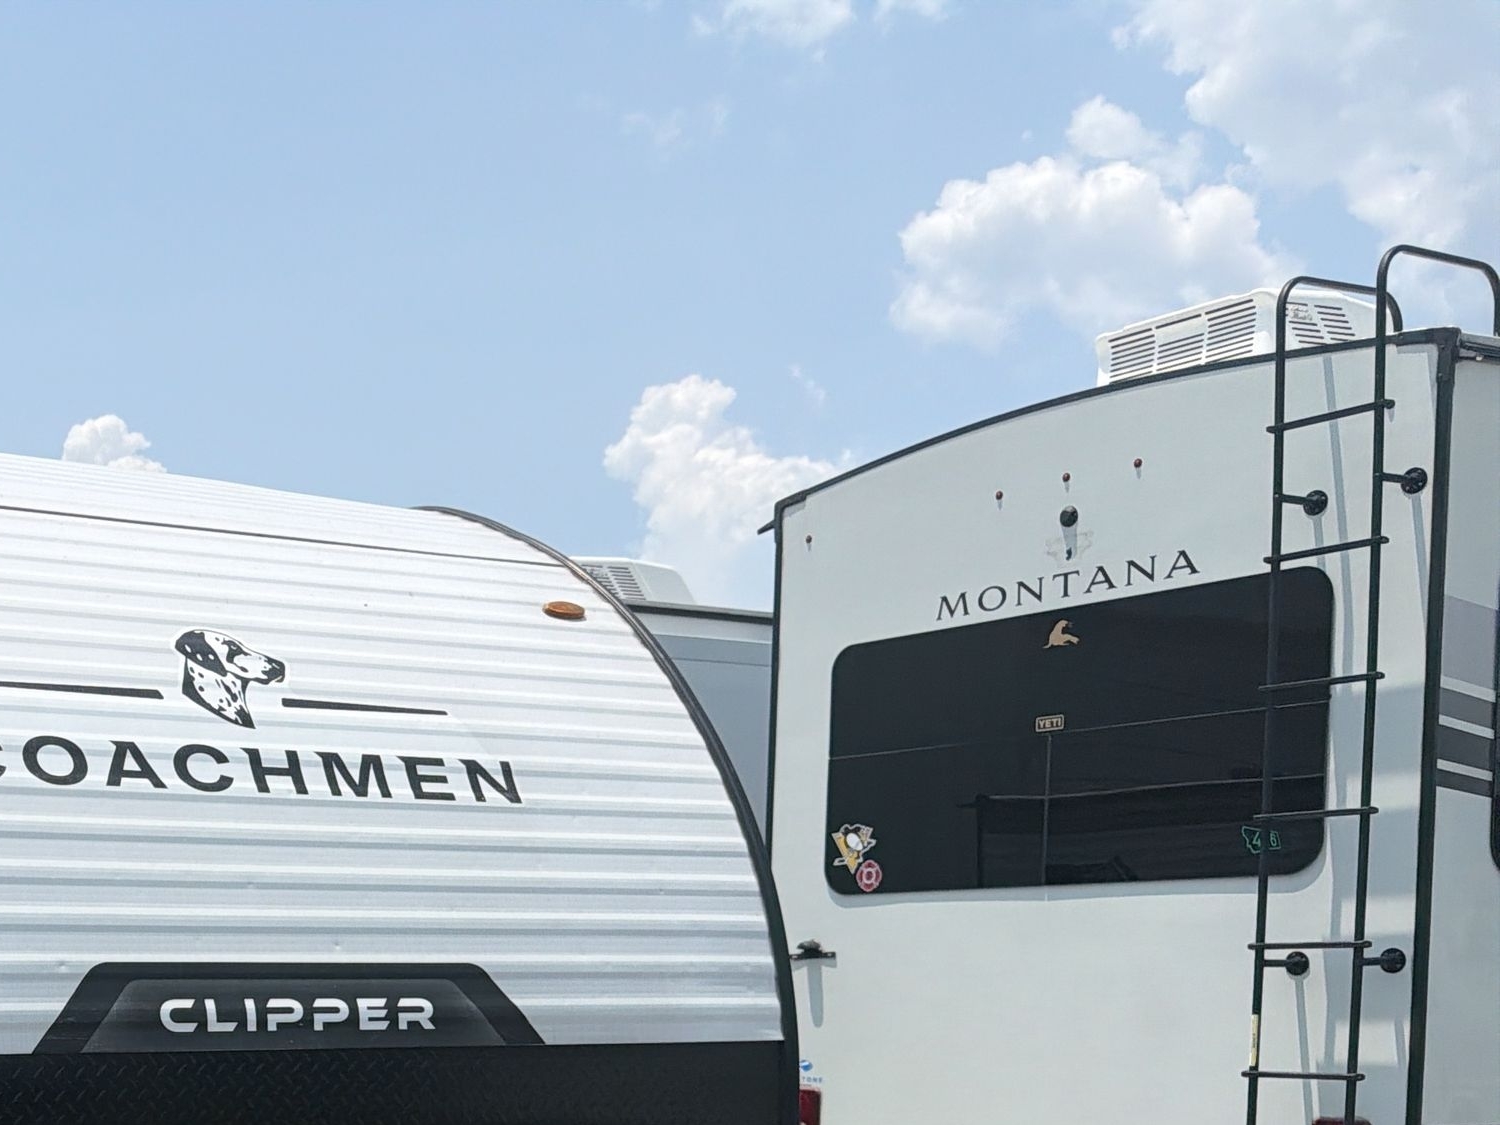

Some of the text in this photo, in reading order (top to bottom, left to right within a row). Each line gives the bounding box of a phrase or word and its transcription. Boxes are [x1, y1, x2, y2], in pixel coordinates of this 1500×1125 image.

[936, 549, 1200, 621] MONTANA
[1039, 717, 1062, 729] YETI
[1252, 831, 1277, 847] 46
[159, 997, 436, 1033] CLIPPER
